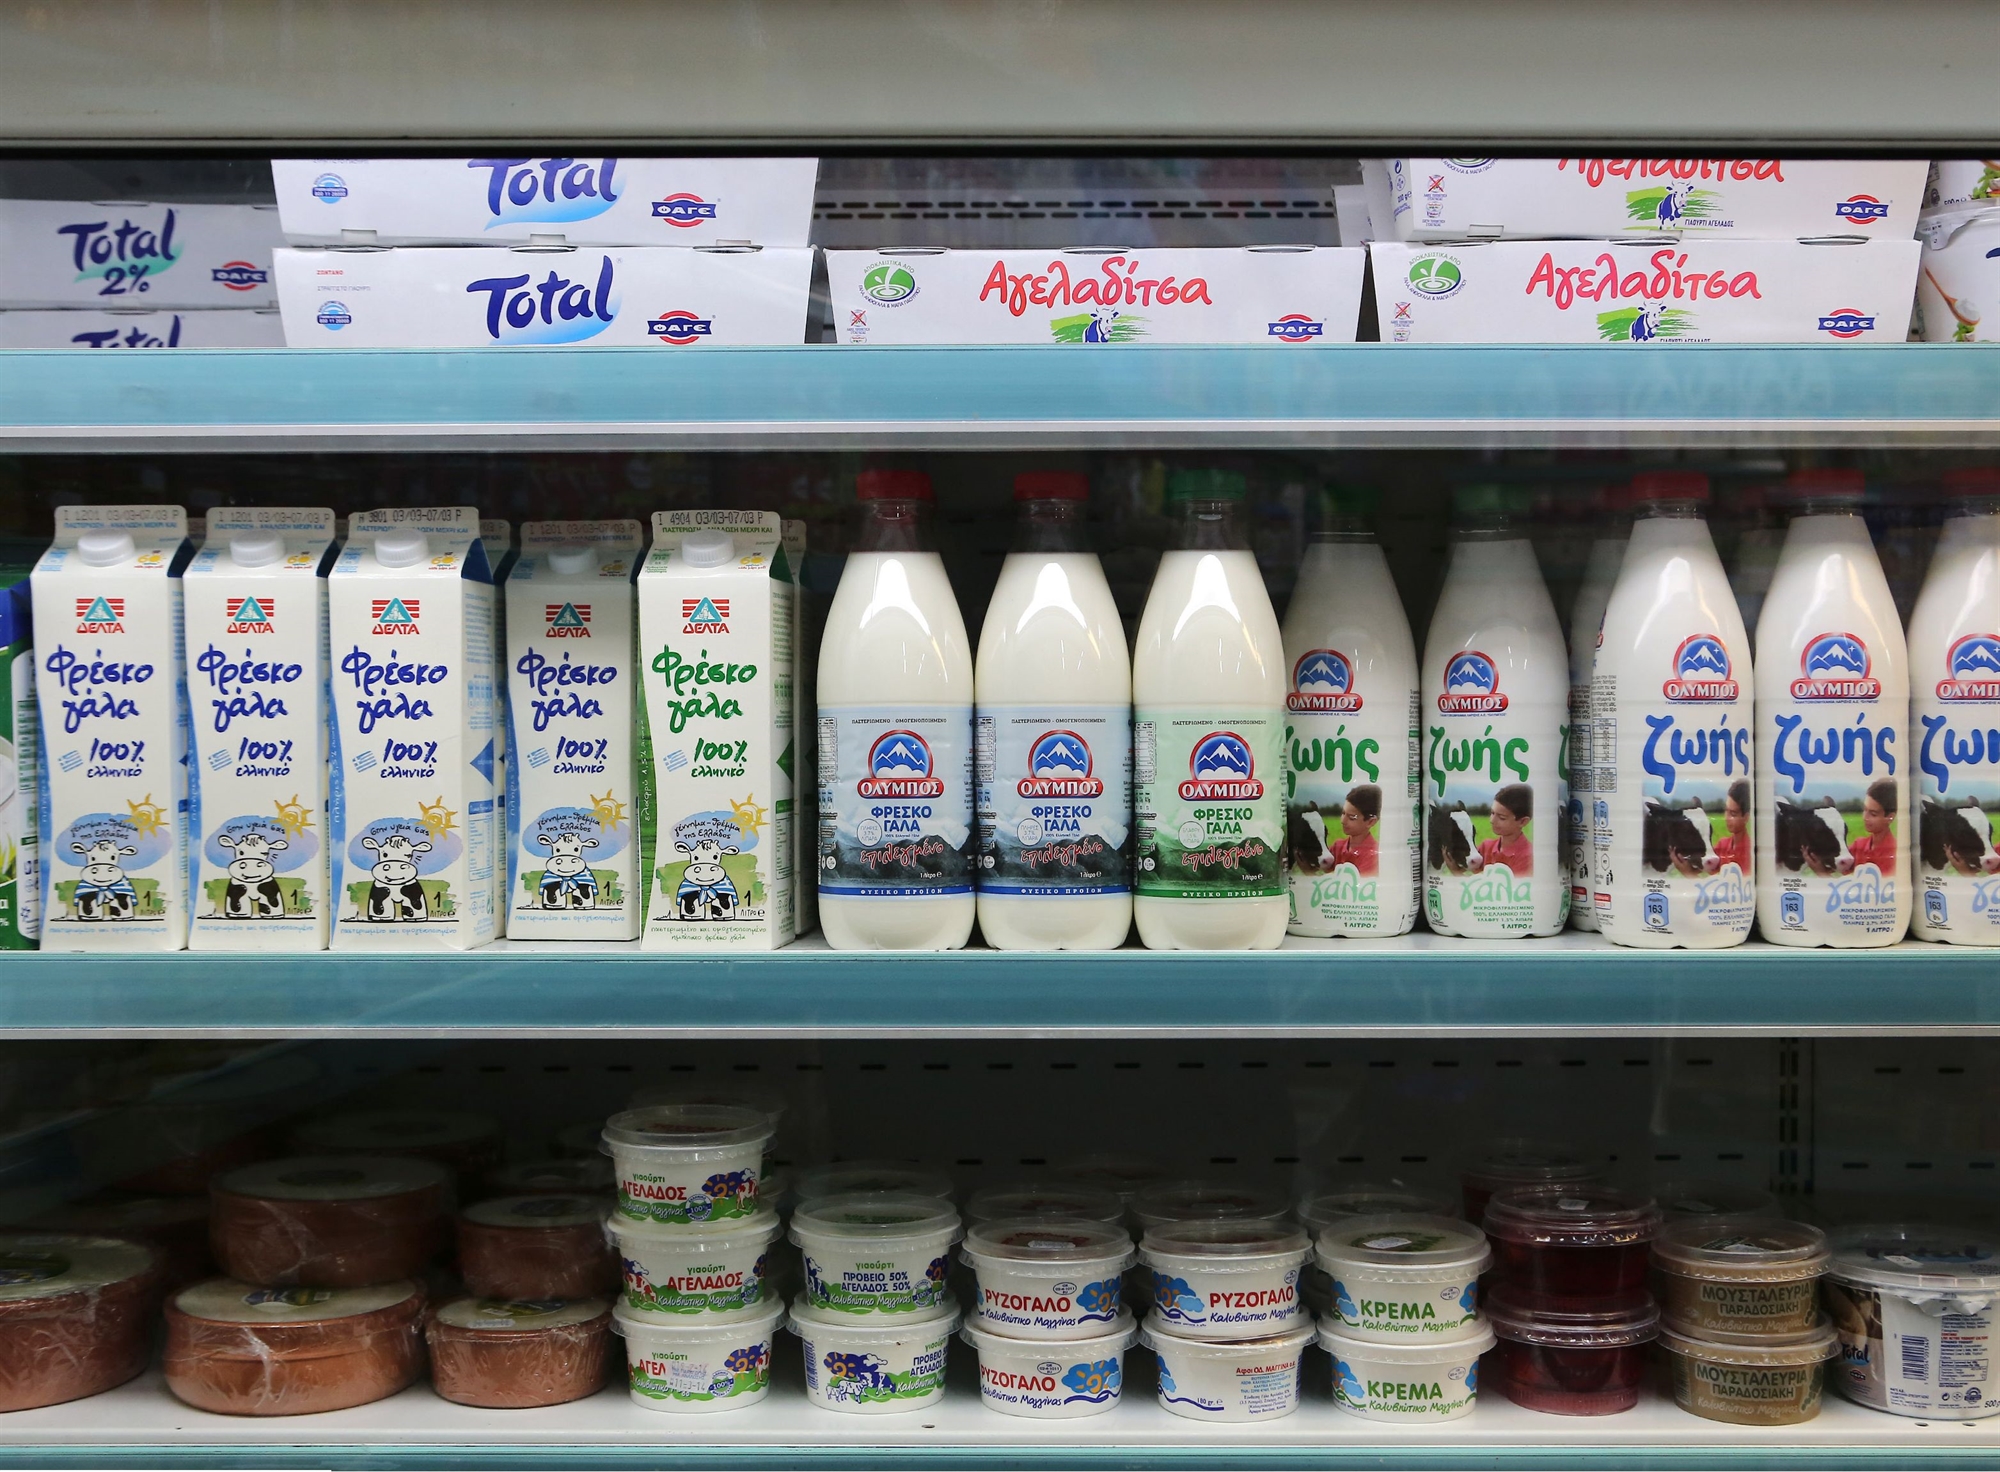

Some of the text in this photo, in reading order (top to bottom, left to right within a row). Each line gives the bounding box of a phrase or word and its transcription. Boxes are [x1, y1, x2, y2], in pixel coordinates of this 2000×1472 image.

[468, 158, 617, 216] Total
[58, 208, 176, 273] Total
[99, 265, 150, 296] 2%
[980, 256, 1213, 317] Αγελαδίτσα
[1526, 249, 1762, 310] Αγελαδίτσα
[466, 255, 615, 339] Total
[392, 509, 452, 522] 03/03-07/03
[695, 511, 754, 524] 03/03-07/03
[76, 622, 125, 634] ΔΕΛΤΑ
[227, 622, 275, 634] ΔΕΛΤΑ
[372, 623, 420, 635] ΔΕΛΤΑ
[546, 627, 591, 638] ΔΕΛΤΑ
[682, 623, 730, 634] ΔΕΛΤΑ
[46, 644, 154, 696] Φρέσκο
[196, 643, 303, 696] Φρέσκο
[341, 645, 448, 697] Φρέσκο
[516, 647, 617, 697] Φρέσκο
[651, 644, 758, 697] Φρέσκο
[1666, 683, 1737, 699] ΟΛΥΜΠΟΣ
[1795, 681, 1877, 697] ΟΛΥΜΠΟΣ
[1940, 683, 2000, 698] ΟΛΥΜΠ
[62, 687, 140, 733] γάλα
[212, 687, 289, 733] γάλα
[356, 689, 433, 734] γάλα
[531, 688, 604, 732] γάλα
[667, 688, 743, 734] γάλα
[1288, 696, 1359, 710] ΟΛΥΜΠΟΣ
[1439, 697, 1504, 710] ΟΛΥΜΠΟΣ
[89, 738, 145, 763] 100%
[238, 737, 293, 763] 100%
[383, 739, 438, 764] 100%
[555, 736, 608, 761] 100%
[693, 737, 748, 764] 100%
[1642, 714, 1750, 794] ζωής
[1773, 711, 1896, 794] ζωής
[1920, 714, 2000, 794] ζω
[553, 761, 605, 775] ελληνικό
[1428, 724, 1529, 798] ζωής
[87, 764, 142, 778] ελληνικό
[236, 763, 291, 778] ελληνικό
[380, 764, 435, 779] ελληνικό
[691, 764, 745, 778] ελληνικό
[860, 780, 941, 796] ΟΛΥΜΠΟΣ
[1020, 780, 1101, 796] ΟΛΥΜΠΟΣ
[1181, 782, 1262, 797] ΟΛΥΜΠΟΣ
[870, 805, 933, 819] ΦΡΕΣΚΟ
[1031, 805, 1093, 819] ΦΡΕΣΚΟ
[1193, 807, 1253, 821] ΦΡΕΣΚΟ
[883, 819, 921, 832] ΓΑΛΑ
[1044, 818, 1081, 832] ΓΑΛΑ
[1206, 821, 1243, 834] ΓΑΛΑ
[290, 888, 298, 906] 1
[603, 880, 611, 897] 1
[1310, 867, 1377, 910] γάλα
[1459, 867, 1532, 911] γάλα
[1693, 866, 1753, 915] γάλα
[1824, 867, 1896, 914] γάλα
[143, 890, 151, 907] 1
[433, 891, 441, 908] 1
[744, 890, 751, 907] 1
[1928, 901, 1942, 910] 163
[1648, 904, 1663, 914] 163
[1785, 903, 1799, 912] 163
[622, 1180, 688, 1201] ΑΓΕΛΑΔΟΣ
[687, 1264, 726, 1275] γιαούρτι
[855, 1261, 895, 1272] γιαούρτι
[667, 1272, 744, 1291] ΑΓΕΛΑΔΟΣ
[843, 1271, 908, 1282] ΠΡΟΒΕΙΟ 50%
[841, 1281, 911, 1293] ΑΓΕΛΑΔΟΣ 50%
[1702, 1282, 1810, 1303] ΜΟΥΣΤΑΛΕΥΡΙΑ
[985, 1288, 1071, 1313] ΡΥΖΟΓΑΛΟ
[1209, 1285, 1294, 1308] ΡΥΖΟΓΑΛΟ
[1360, 1298, 1436, 1320] ΚΡΕΜΑ
[1719, 1302, 1800, 1316] ΠΑΡΑΔΟΣΙΑΚΗ
[651, 1351, 688, 1361] γιαούρτι
[1841, 1343, 1870, 1364] Total
[980, 1363, 1056, 1392] ΡΥΖΟΓΑΛΟ
[1696, 1363, 1808, 1386] ΜΟΥΣΤΑΛΕΥΡΙΑ
[1367, 1380, 1443, 1401] ΚΡΕΜΑ
[1712, 1383, 1795, 1400] ΠΑΡΑΔΟΣΙΑΚΗ
